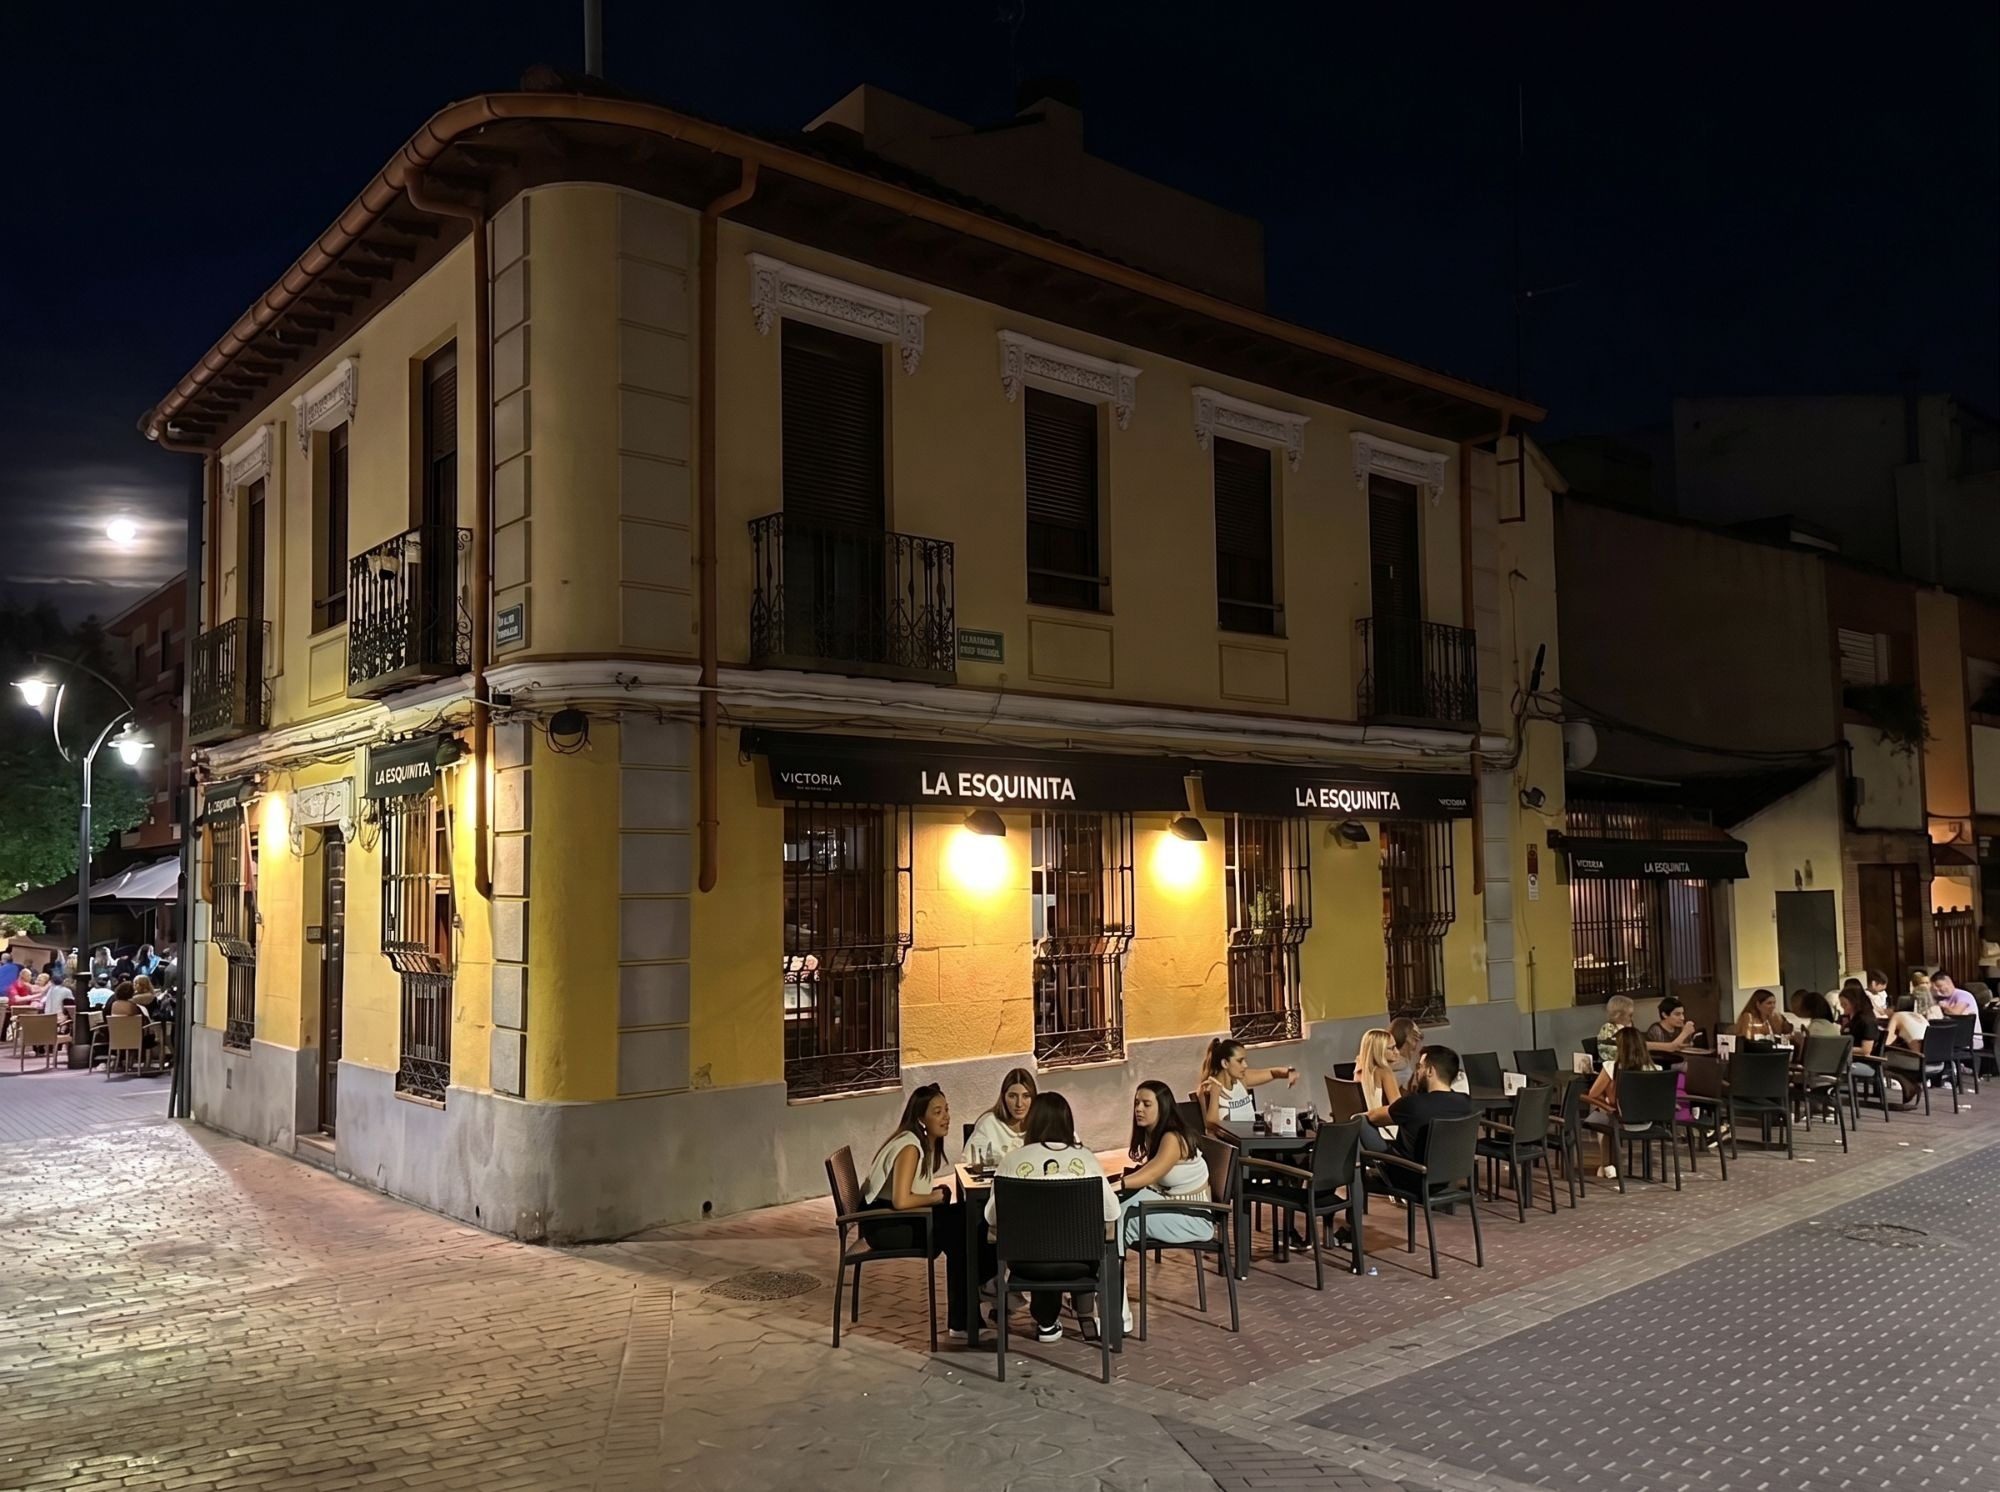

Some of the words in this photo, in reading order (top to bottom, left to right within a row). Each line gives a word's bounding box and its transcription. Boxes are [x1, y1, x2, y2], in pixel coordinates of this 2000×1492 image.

[375, 770, 385, 785] LA
[386, 762, 431, 784] ESQUINITA
[780, 771, 842, 786] VICTORIA
[921, 771, 952, 796] LA
[958, 773, 1076, 802] ESQUINITA
[1295, 787, 1317, 807] LA
[1320, 788, 1400, 812] ESQUINITA
[1644, 863, 1654, 872] LA
